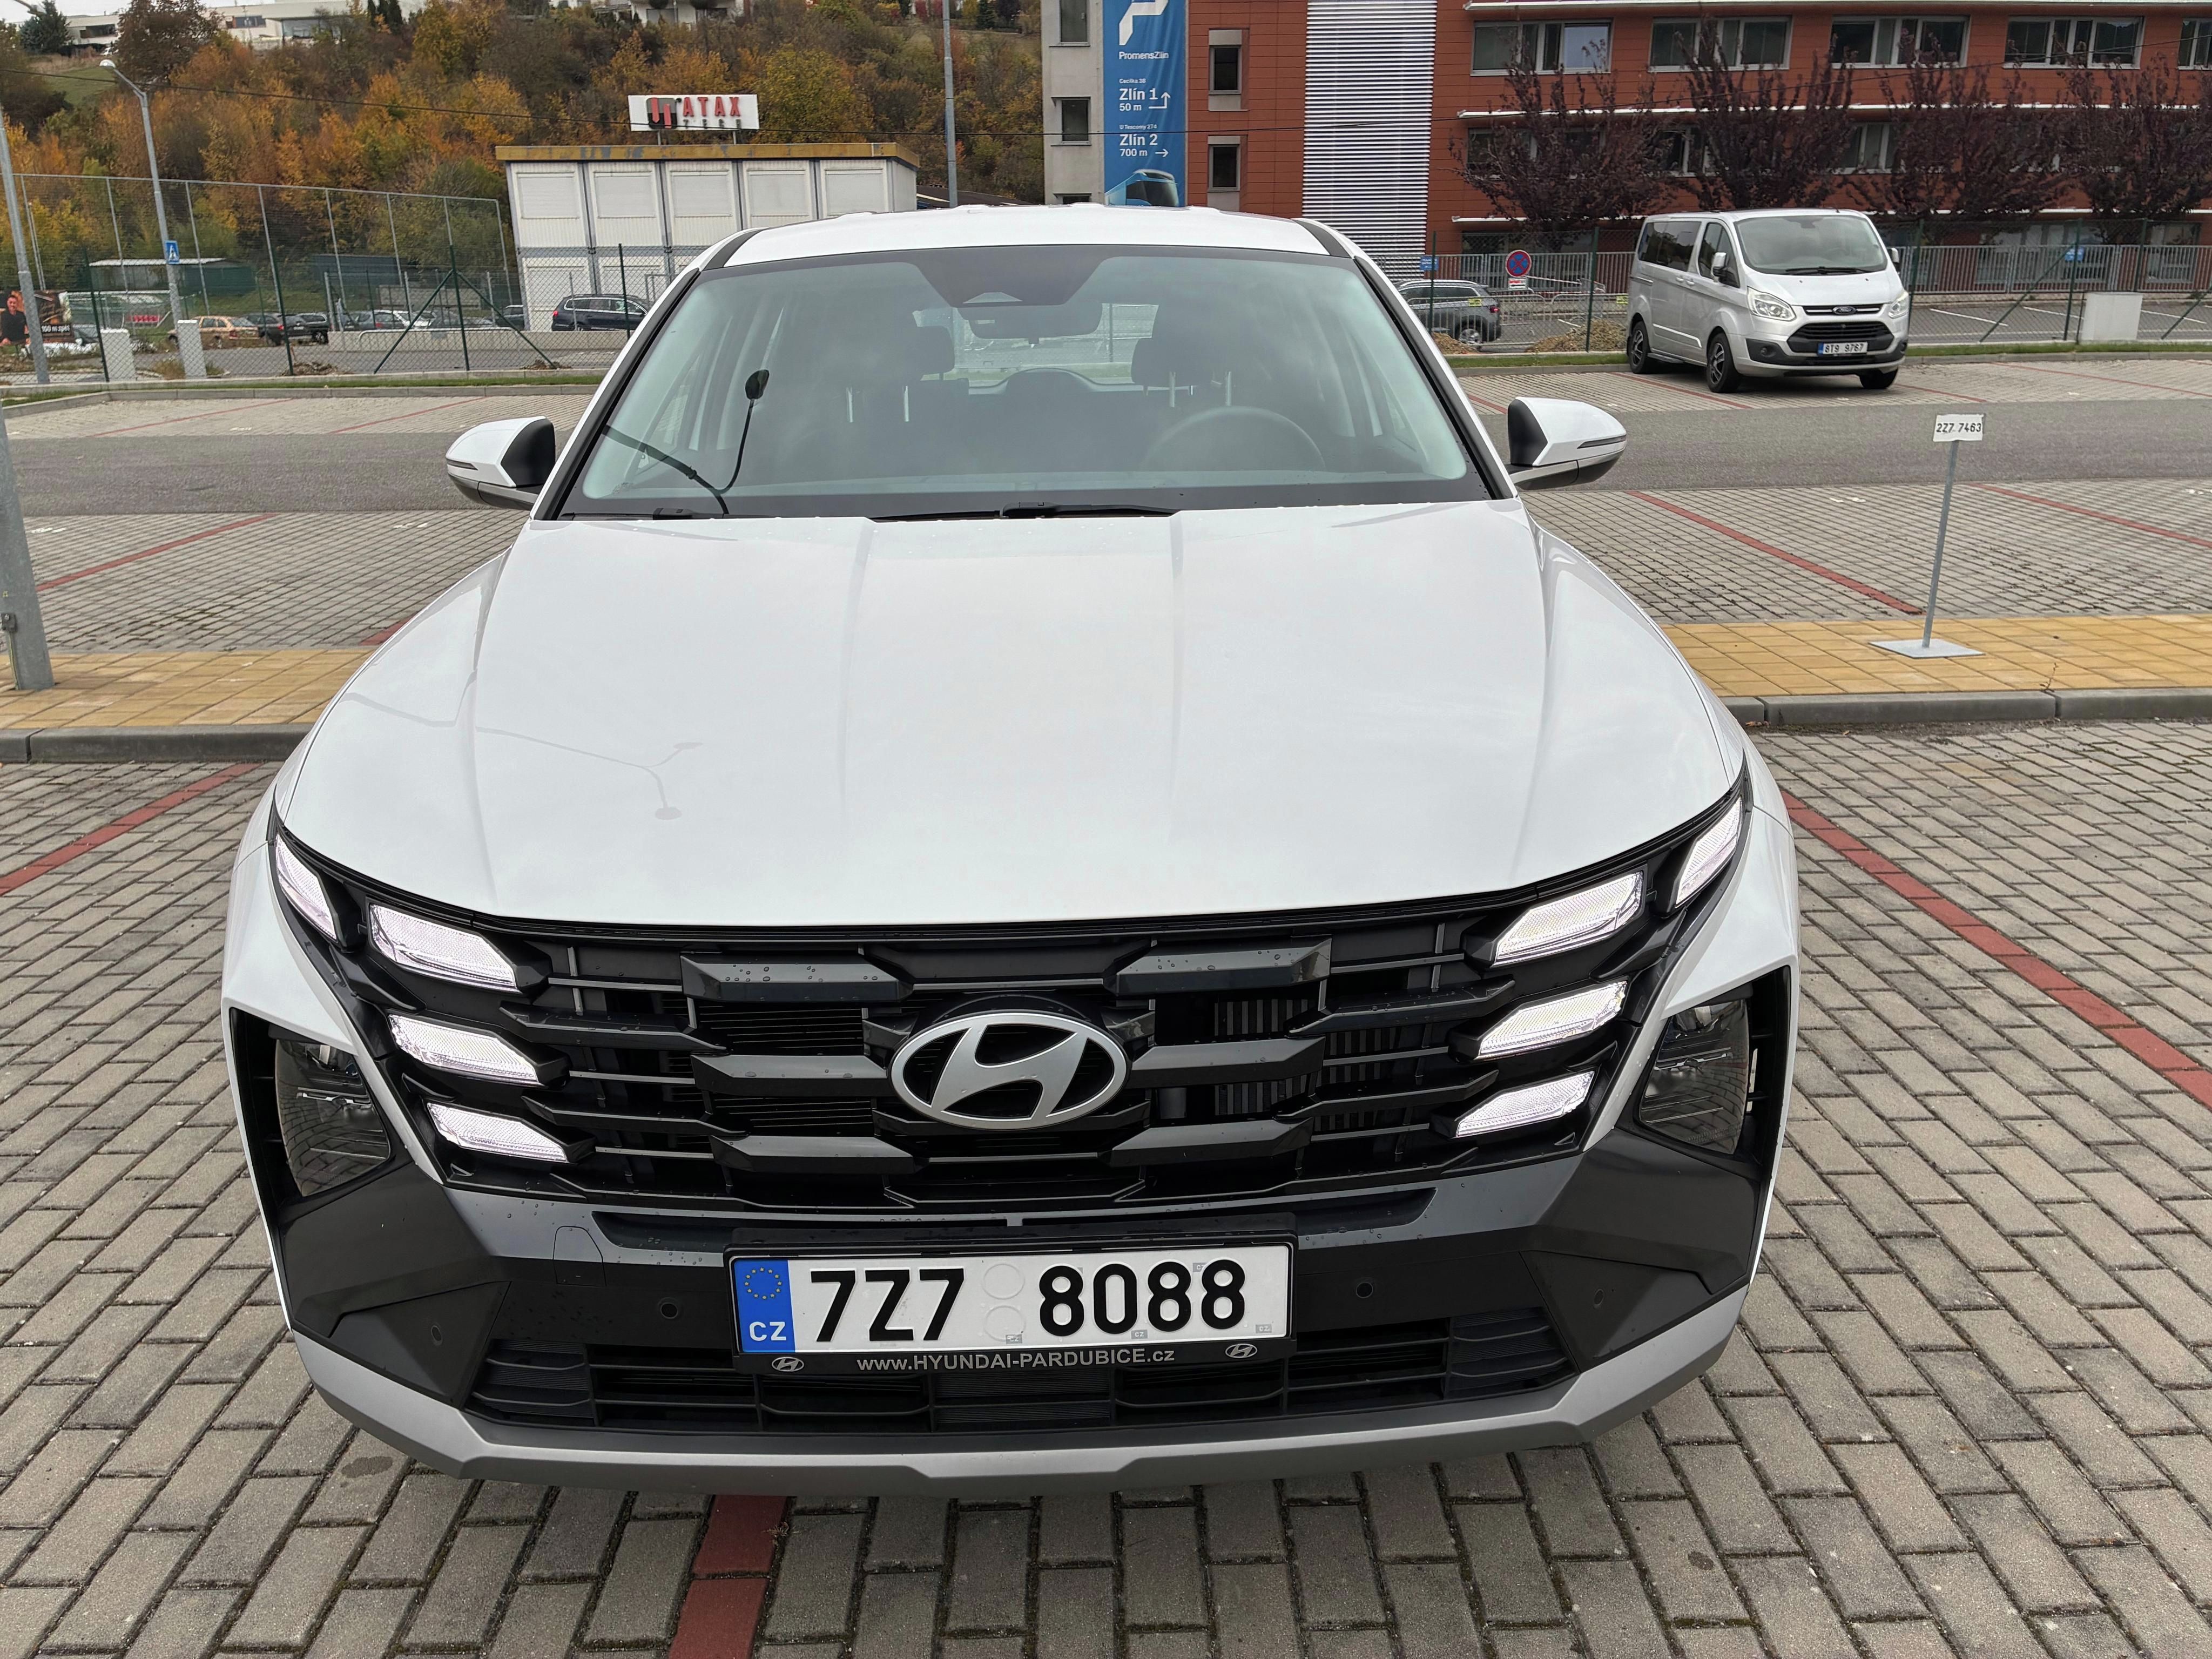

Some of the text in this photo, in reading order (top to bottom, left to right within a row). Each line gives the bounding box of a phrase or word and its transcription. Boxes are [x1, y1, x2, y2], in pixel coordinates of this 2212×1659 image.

[1119, 88, 1158, 100] Zlín 1
[683, 97, 741, 117] ATAX
[1119, 103, 1131, 111] 50
[1119, 133, 1158, 146] Zlín 2
[1119, 149, 1137, 157] 700
[1958, 422, 1981, 433] 7463
[810, 1259, 1246, 1343] 7Z7 8088
[749, 1321, 787, 1341] CZ
